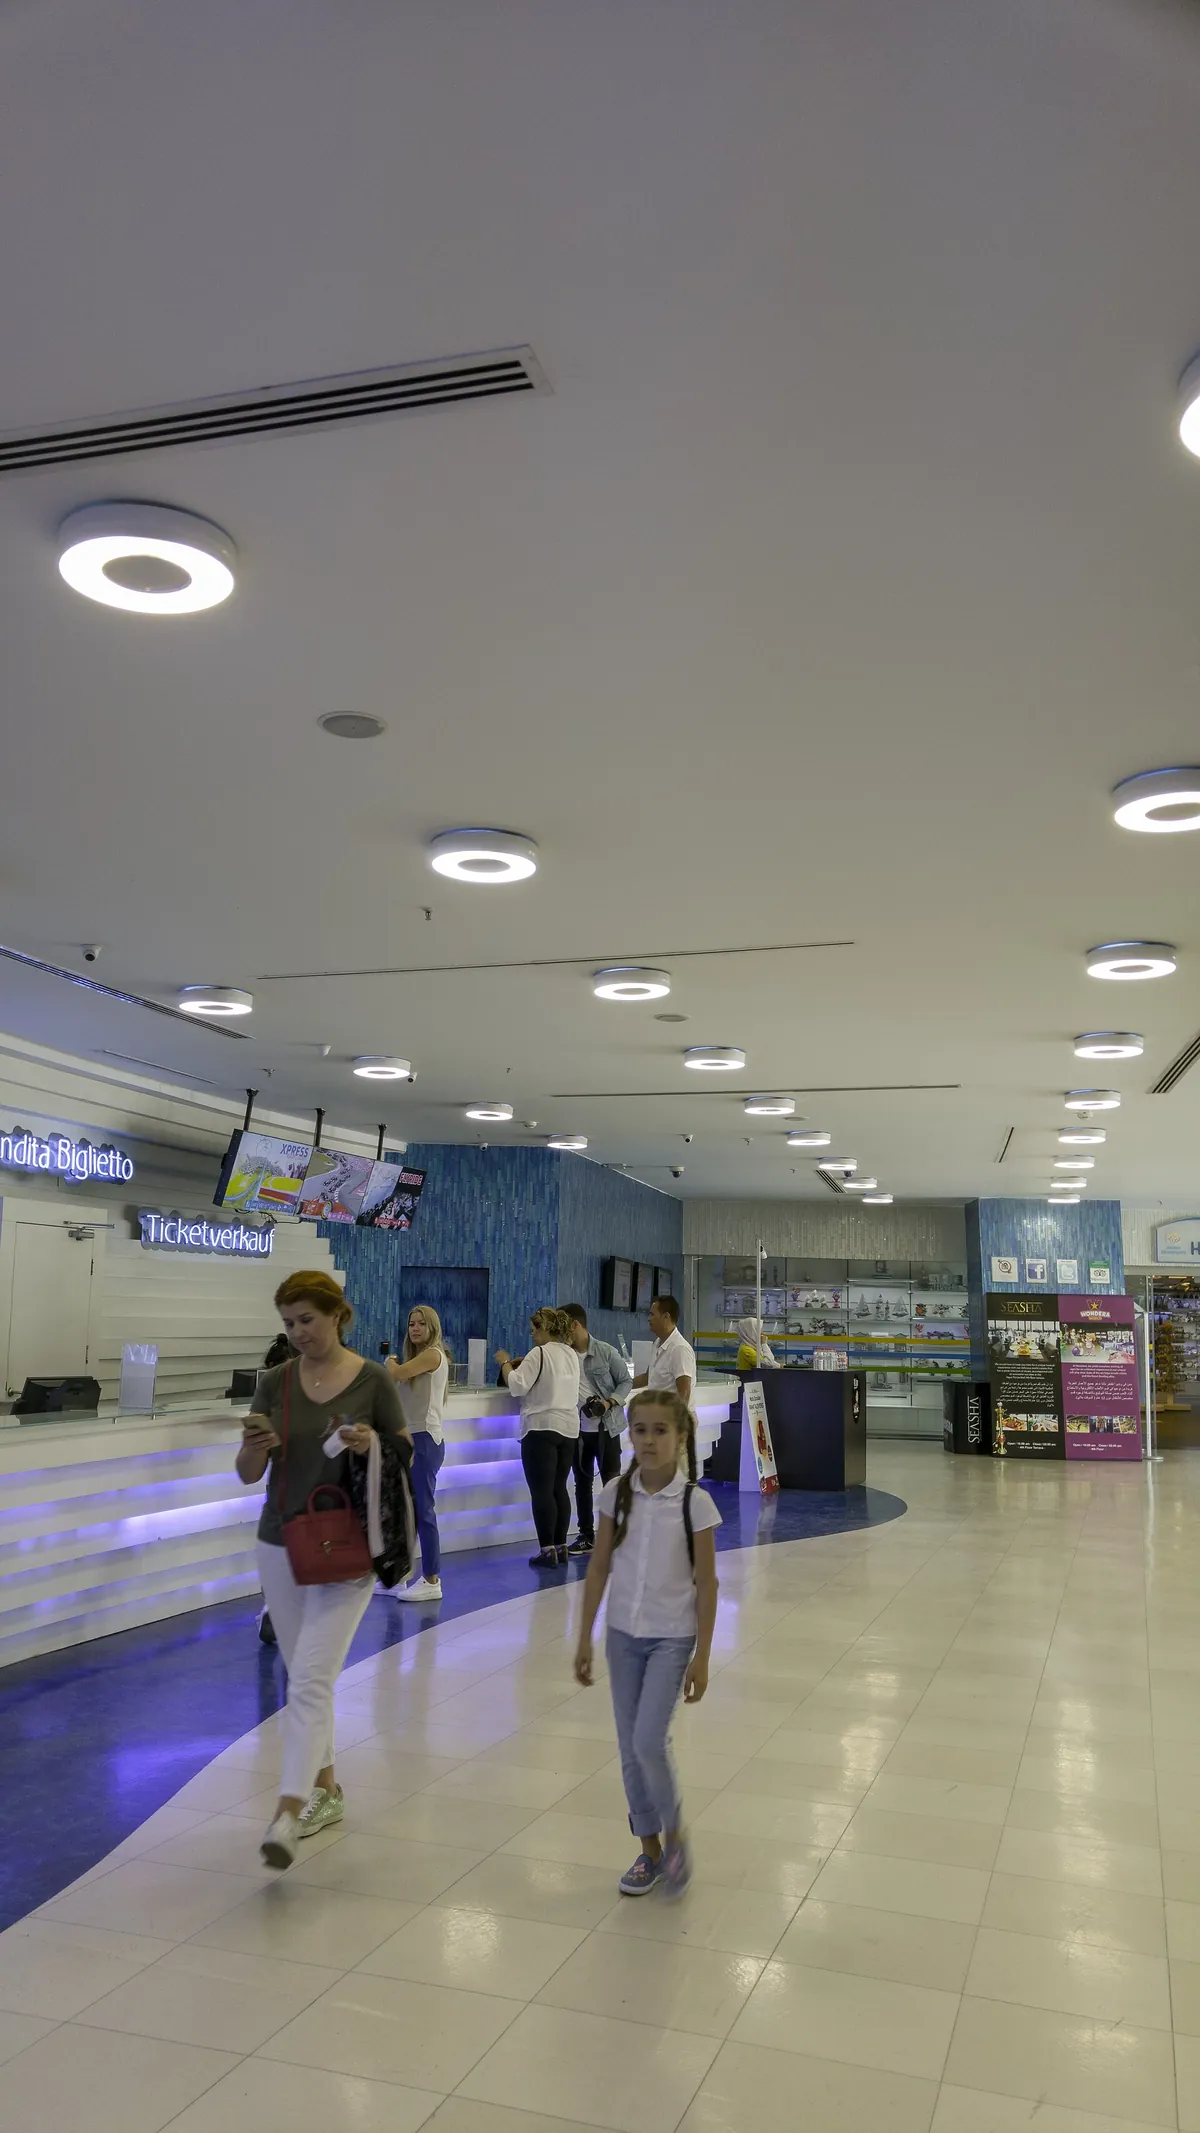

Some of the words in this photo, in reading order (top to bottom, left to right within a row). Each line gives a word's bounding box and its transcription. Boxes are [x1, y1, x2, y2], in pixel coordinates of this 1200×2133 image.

[58, 1138, 133, 1180] Biglietto
[280, 1143, 309, 1158] XPRESS
[147, 1214, 275, 1253] Ticketverkauf
[1000, 1301, 1042, 1313] SEASHA
[1080, 1310, 1111, 1318] WONDERA
[967, 1396, 980, 1443] SEASHA
